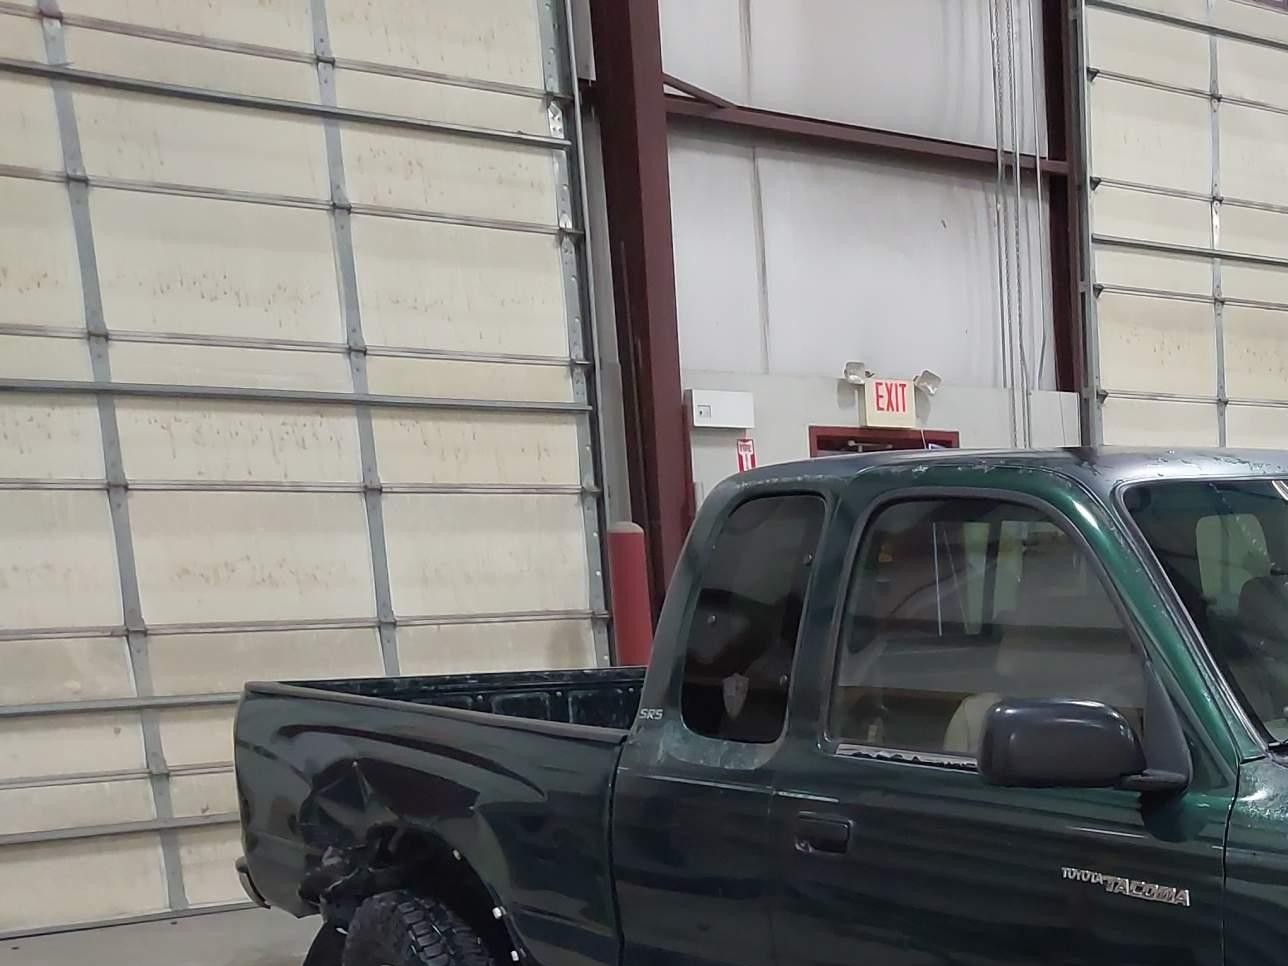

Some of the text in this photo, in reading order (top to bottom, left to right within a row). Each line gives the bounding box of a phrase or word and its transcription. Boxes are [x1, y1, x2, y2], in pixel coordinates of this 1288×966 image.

[875, 382, 906, 412] EXIT
[1061, 867, 1190, 907] TOYOTA TACOMA
